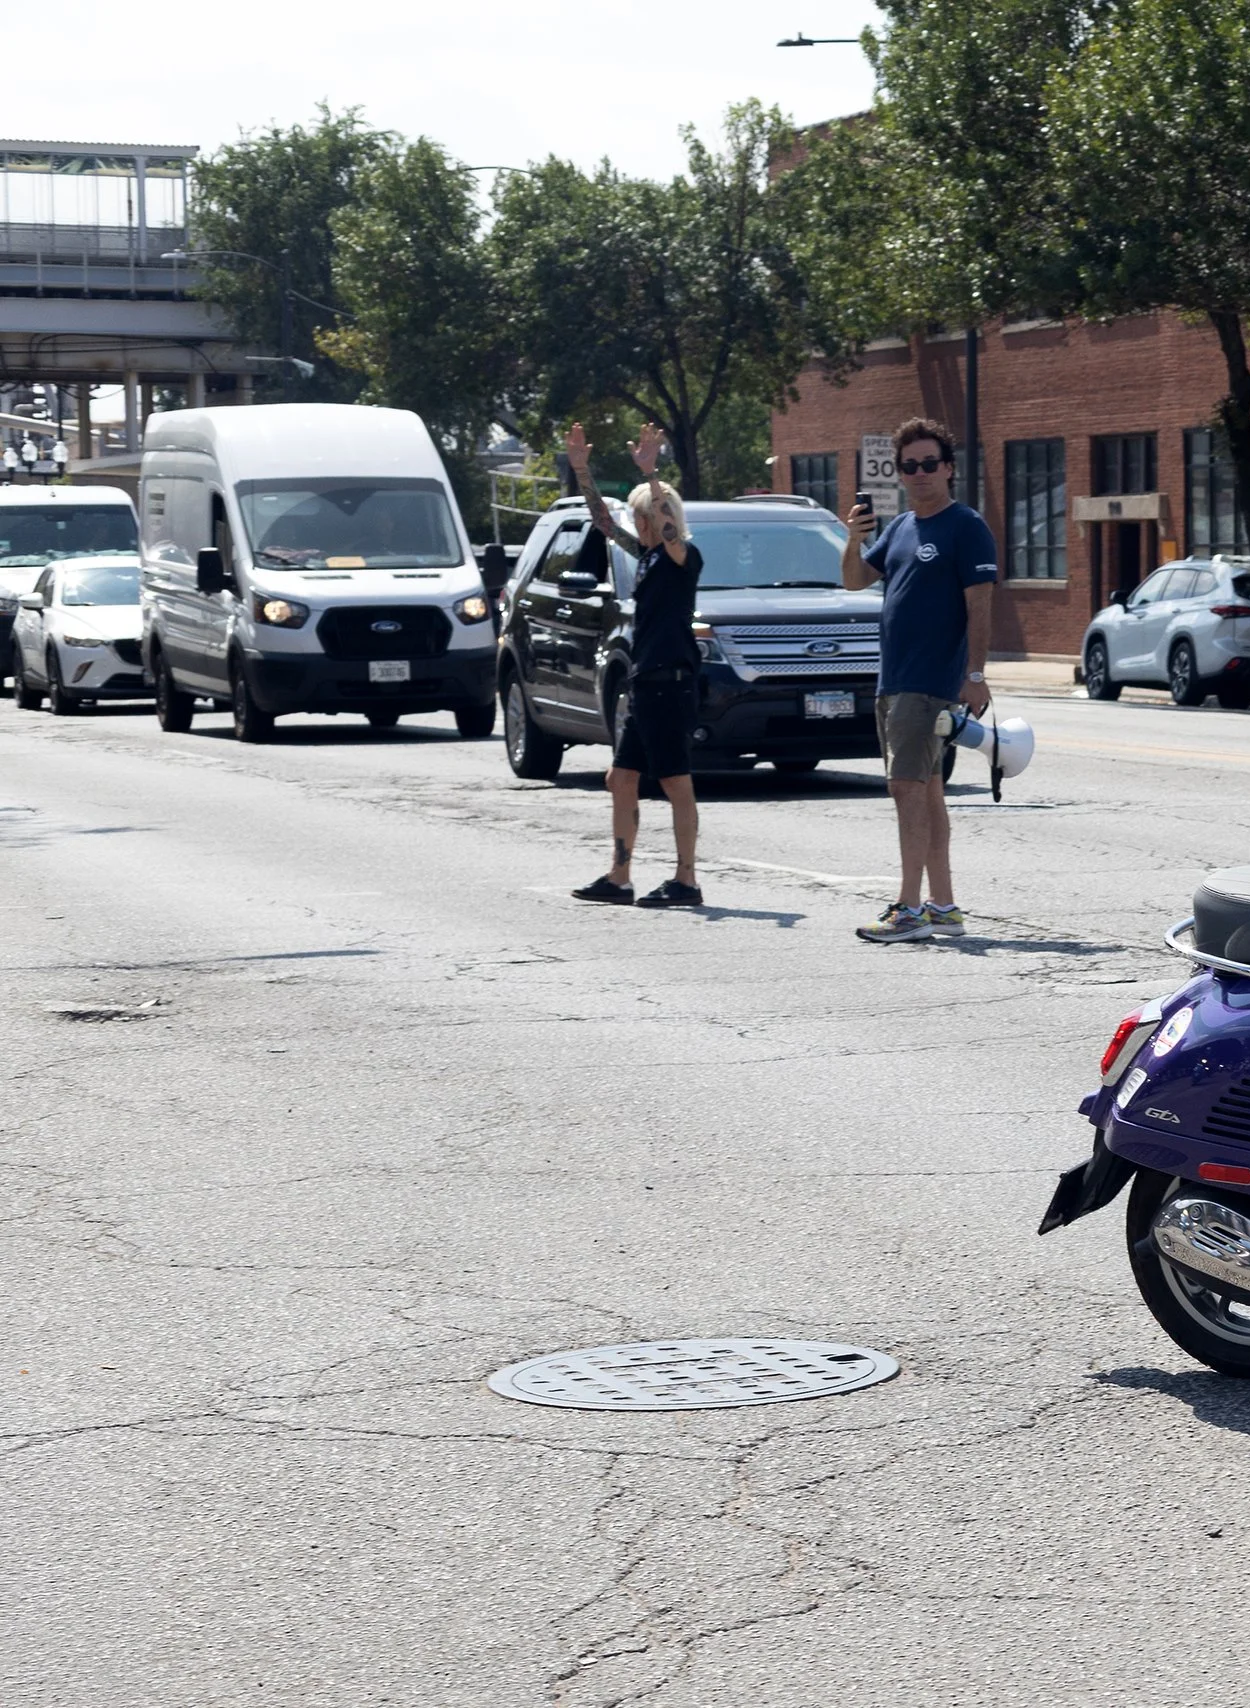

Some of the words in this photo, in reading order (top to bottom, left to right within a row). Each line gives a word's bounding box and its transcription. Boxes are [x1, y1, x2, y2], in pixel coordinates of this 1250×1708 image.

[865, 438, 889, 447] SPEE
[866, 460, 895, 477] 30
[812, 641, 835, 653] Ford
